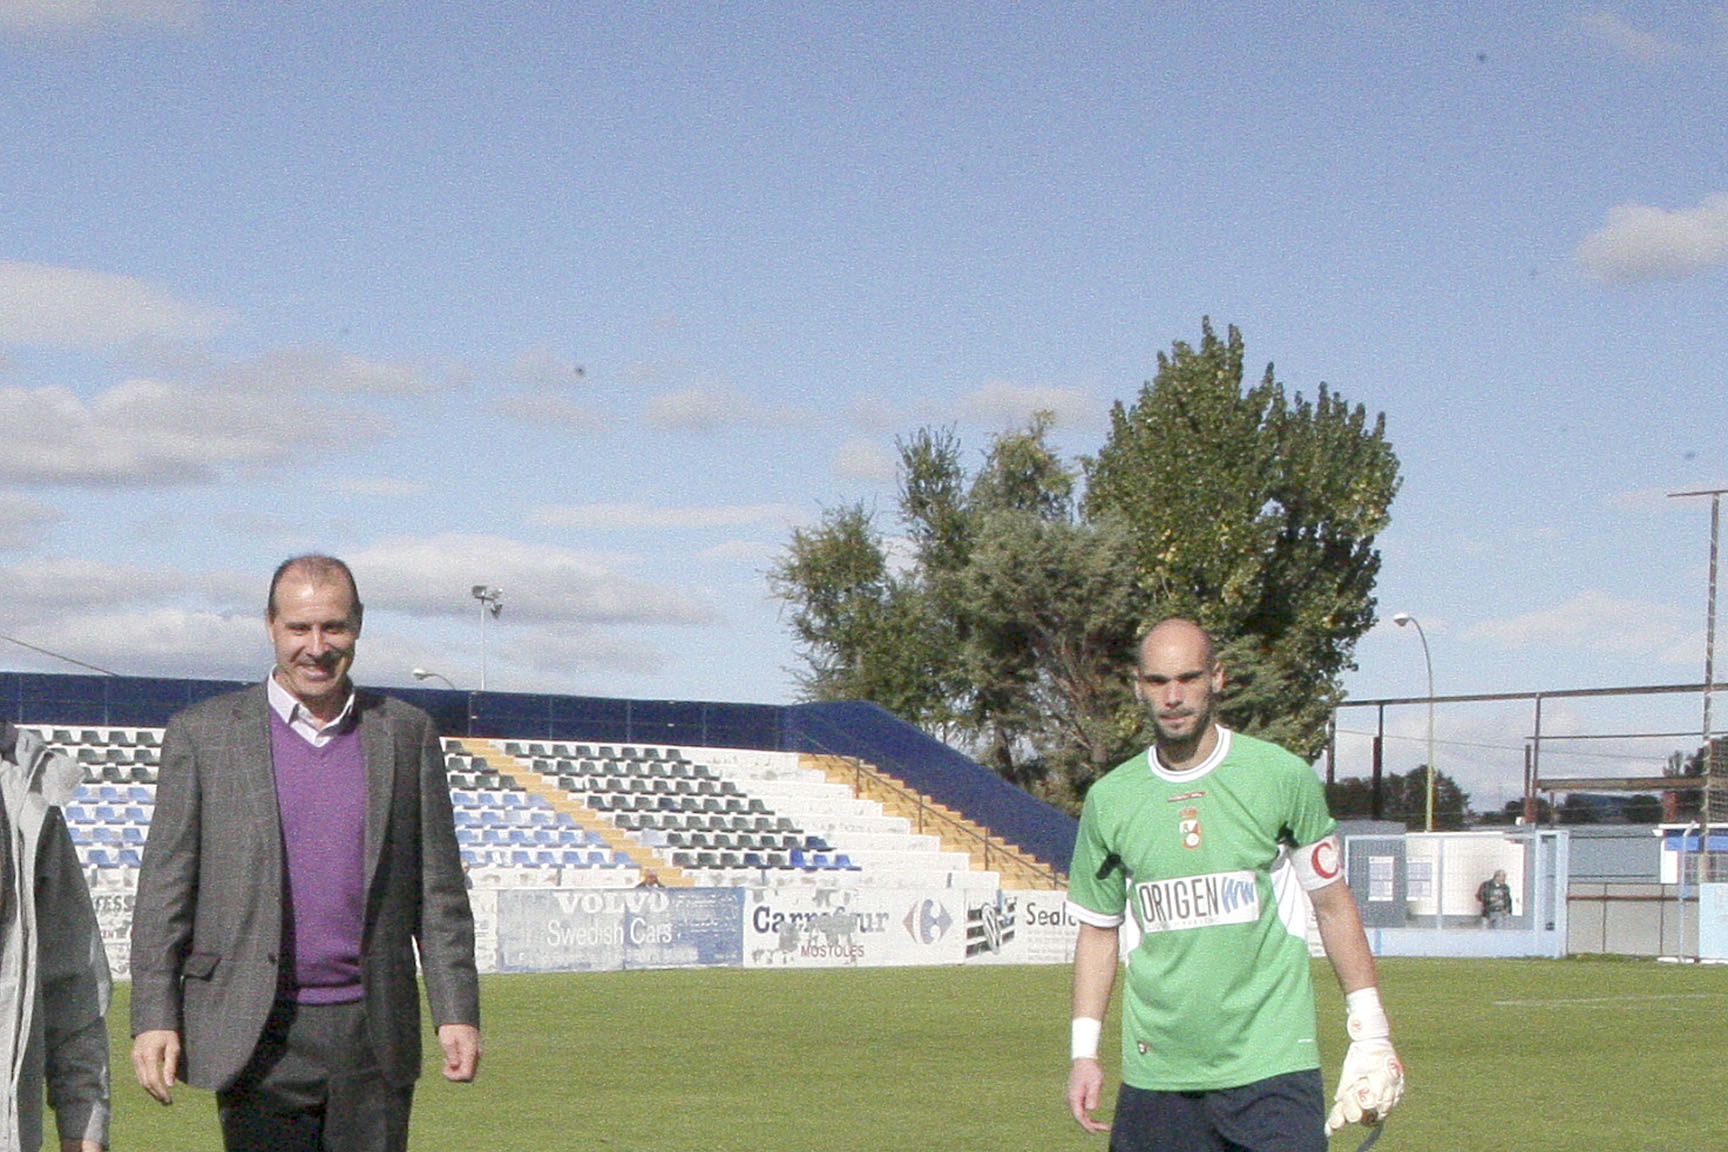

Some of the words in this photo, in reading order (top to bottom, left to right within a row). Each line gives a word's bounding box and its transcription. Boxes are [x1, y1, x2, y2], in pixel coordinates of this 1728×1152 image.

[1311, 842, 1340, 879] C
[553, 891, 670, 914] VOLVO
[1139, 877, 1219, 923] ORIGEN
[546, 919, 624, 946] Swedish
[630, 917, 672, 944] Cars
